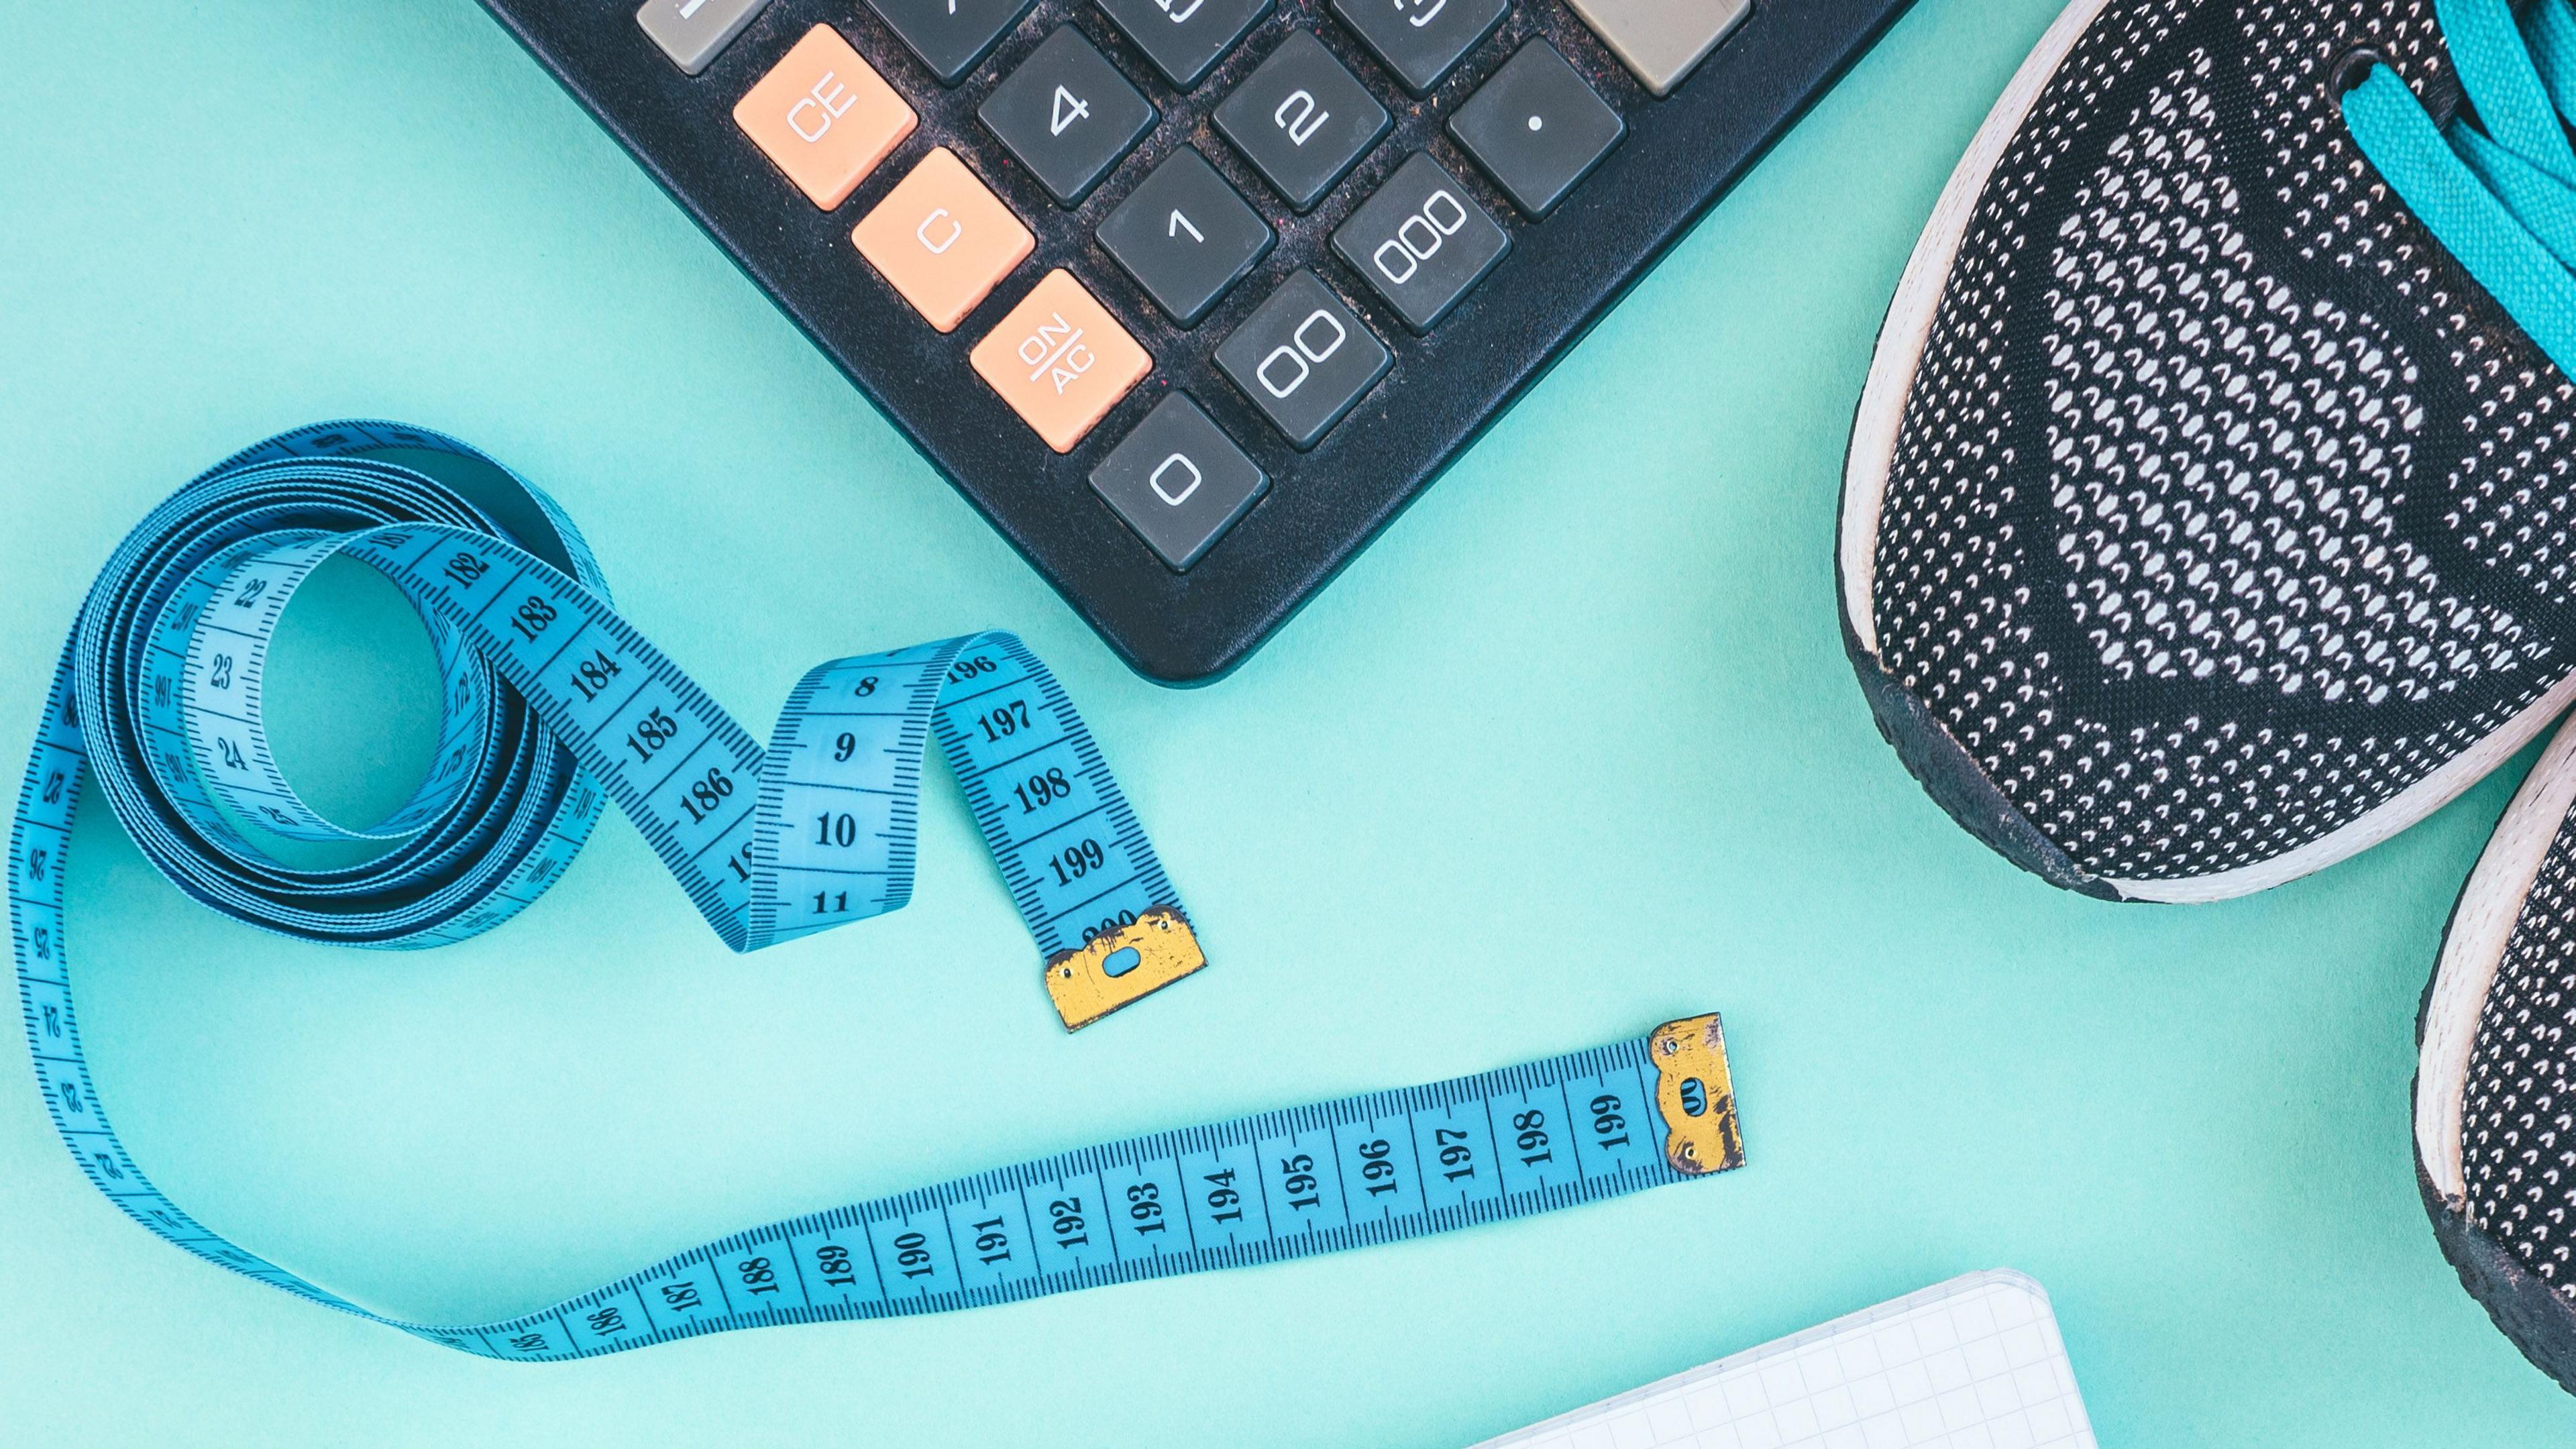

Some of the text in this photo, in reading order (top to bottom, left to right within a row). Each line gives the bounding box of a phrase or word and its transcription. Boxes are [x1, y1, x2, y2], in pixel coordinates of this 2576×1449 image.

[787, 71, 857, 143] CE
[1050, 85, 1089, 136] 4
[1275, 91, 1329, 146] 2
[916, 208, 962, 254] C
[1169, 209, 1204, 243] 1
[1374, 190, 1466, 284] 000
[1256, 309, 1346, 398] 00
[1150, 453, 1201, 505] 0
[234, 579, 267, 608] 22
[443, 552, 490, 590] 182
[511, 596, 557, 643] 183
[211, 653, 232, 690] 23
[571, 649, 622, 703] 184
[854, 676, 879, 697] 8
[947, 656, 998, 684] 196
[627, 706, 678, 764] 185
[977, 700, 1030, 743] 197
[218, 737, 249, 771] 24
[834, 733, 856, 762] 9
[43, 772, 64, 804] 27
[680, 767, 733, 825] 186
[1014, 767, 1071, 815] 198
[816, 812, 855, 847] 10
[30, 848, 46, 881] 26
[1049, 839, 1104, 887] 199
[812, 891, 849, 914] 11
[61, 1083, 83, 1113] 23
[1513, 1109, 1554, 1167] 198
[1591, 1094, 1630, 1151] 199
[95, 1153, 123, 1179] 22
[1359, 1139, 1398, 1197] 196
[1436, 1128, 1475, 1183] 197
[1203, 1168, 1243, 1225] 194
[1281, 1154, 1320, 1211] 195
[1049, 1197, 1089, 1250] 192
[1127, 1182, 1166, 1236] 193
[894, 1232, 934, 1280] 190
[971, 1215, 1011, 1267] 191
[738, 1256, 780, 1295] 188
[816, 1245, 857, 1287] 189
[661, 1282, 702, 1312] 187
[586, 1307, 627, 1336] 186
